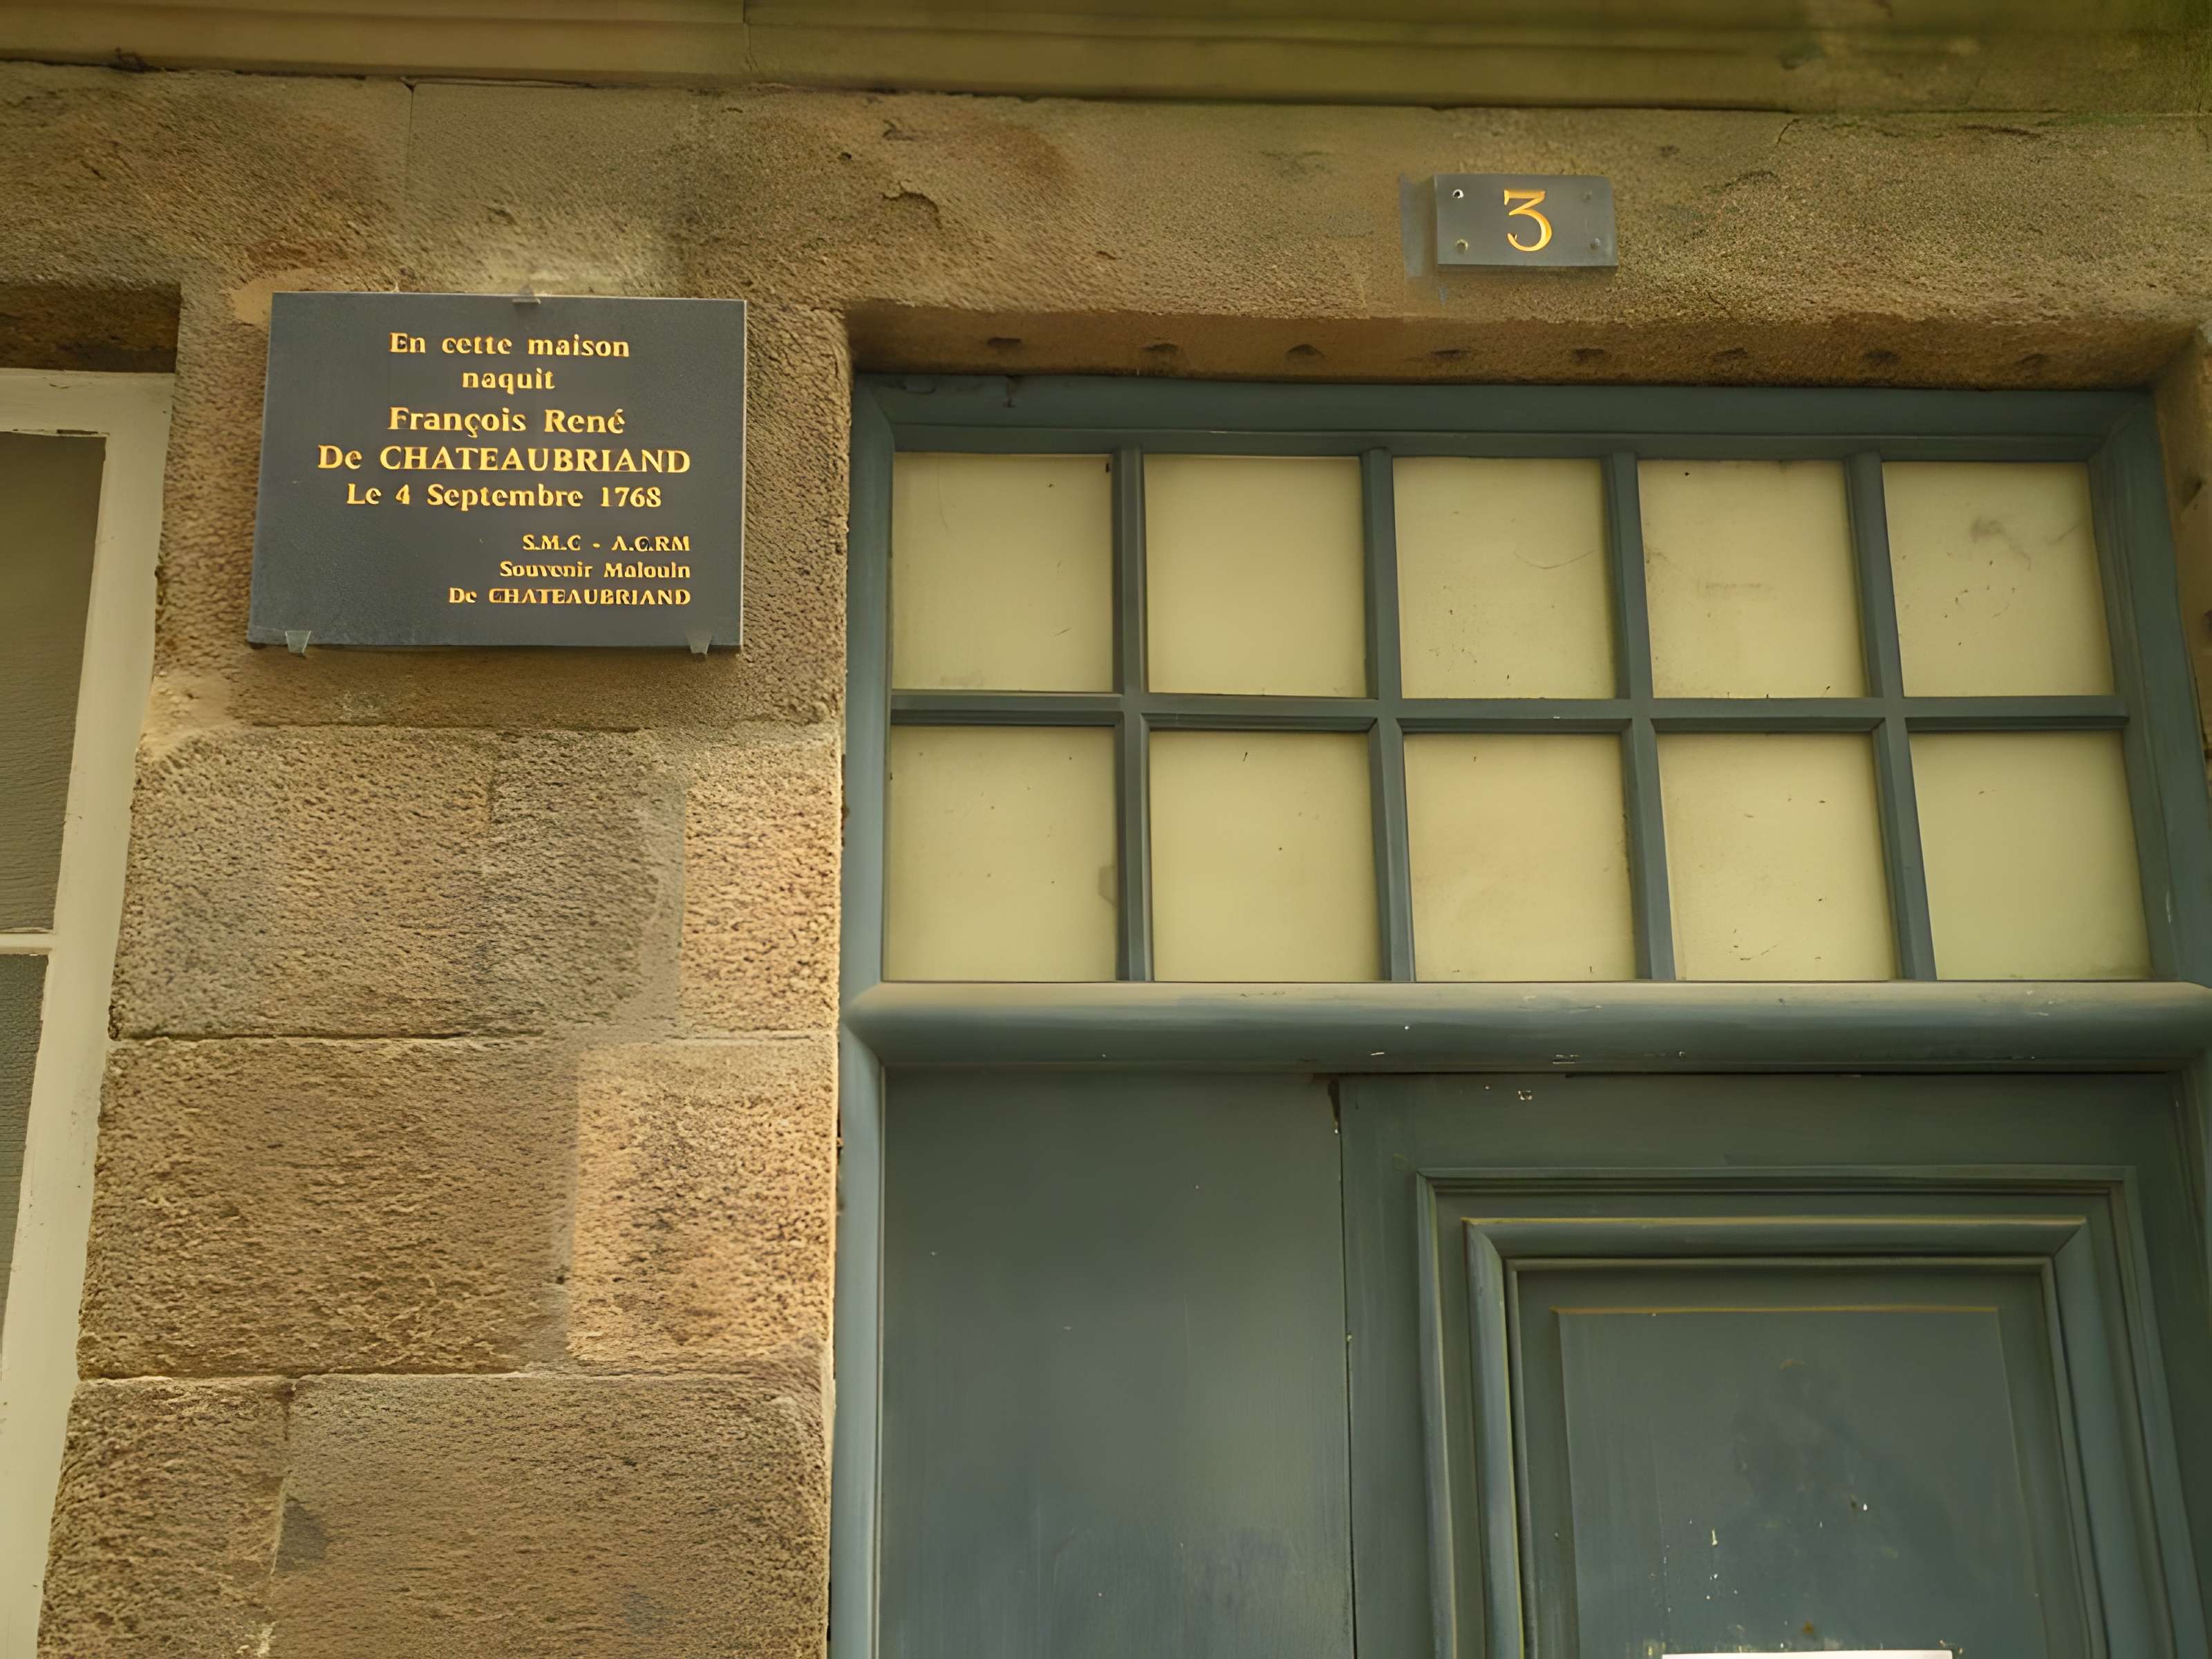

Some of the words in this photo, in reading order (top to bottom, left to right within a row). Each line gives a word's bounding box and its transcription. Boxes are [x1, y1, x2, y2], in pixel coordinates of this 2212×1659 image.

[1503, 189, 1553, 252] 3
[388, 331, 427, 355] En
[439, 334, 514, 355] cette
[526, 333, 631, 359] maison
[460, 366, 556, 396] naquit
[387, 405, 528, 440] François
[543, 408, 627, 435] René
[316, 442, 364, 471] De
[378, 443, 692, 475] CHATEAUBRIAND
[345, 482, 382, 506] Le
[393, 482, 412, 507] 4
[425, 482, 585, 514] Septembre
[599, 485, 663, 509] 1768
[498, 559, 594, 580] Souvenir
[601, 560, 692, 580] Malouin
[447, 585, 479, 605] De
[487, 586, 692, 607] CHATEAUBRIAND
